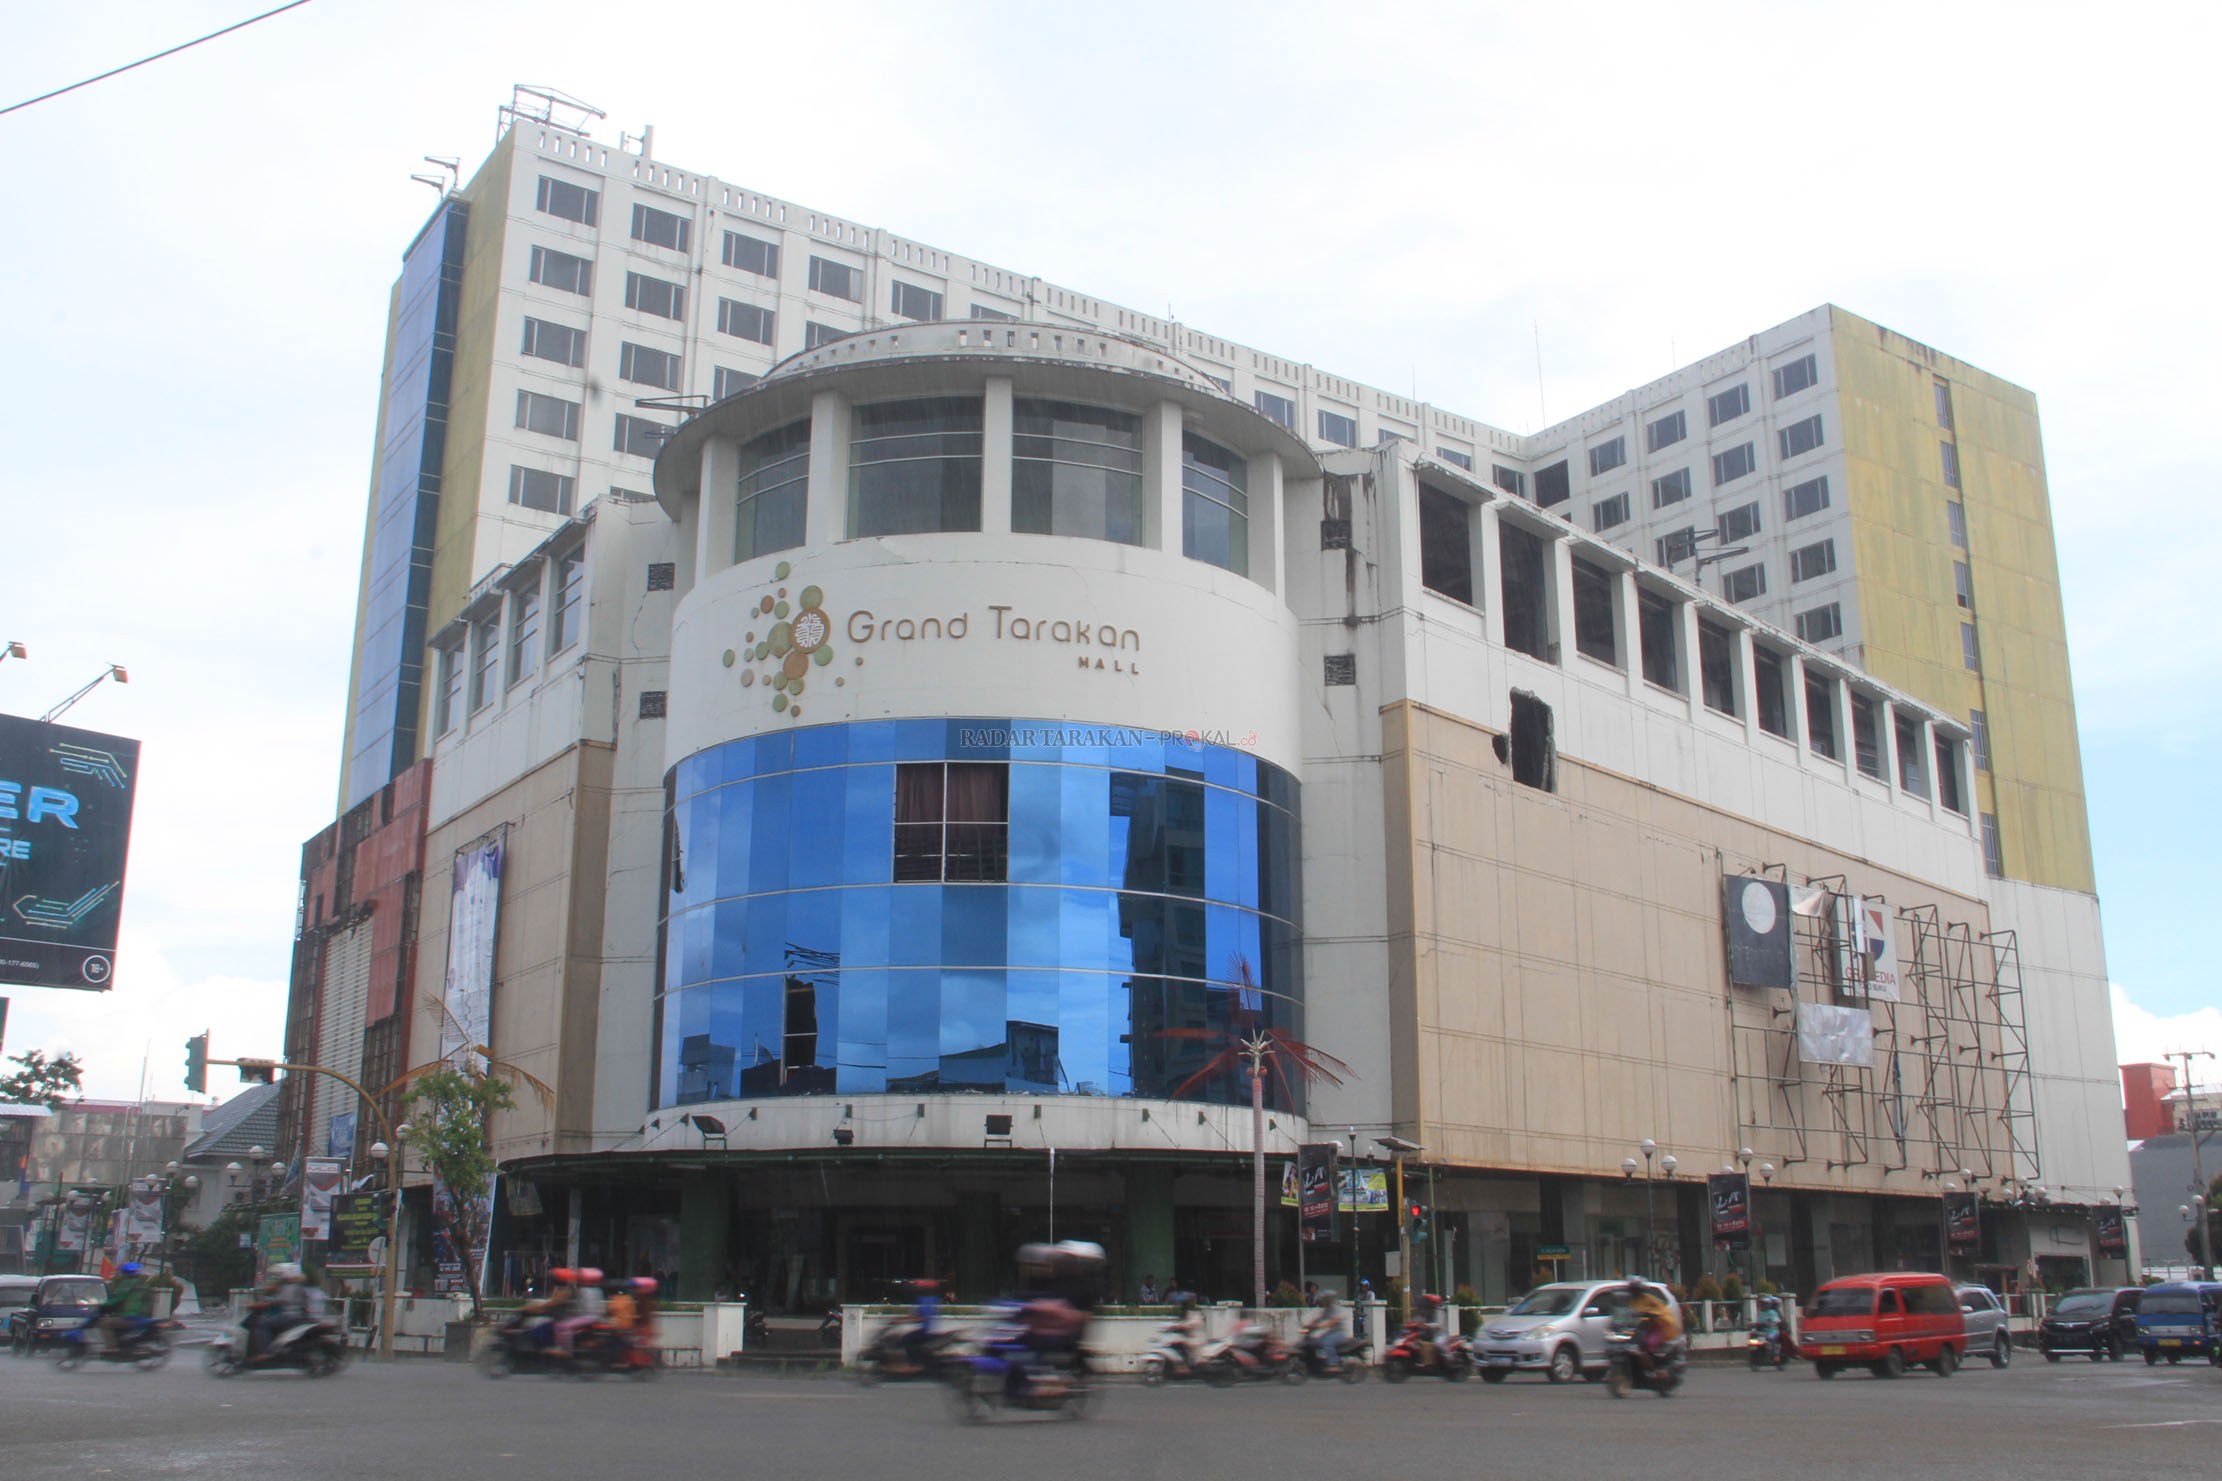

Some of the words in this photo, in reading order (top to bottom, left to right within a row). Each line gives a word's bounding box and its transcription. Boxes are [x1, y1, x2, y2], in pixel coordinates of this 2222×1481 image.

[848, 610, 967, 643] Grand
[988, 605, 1140, 651] Tarakan
[1078, 656, 1139, 675] MALL
